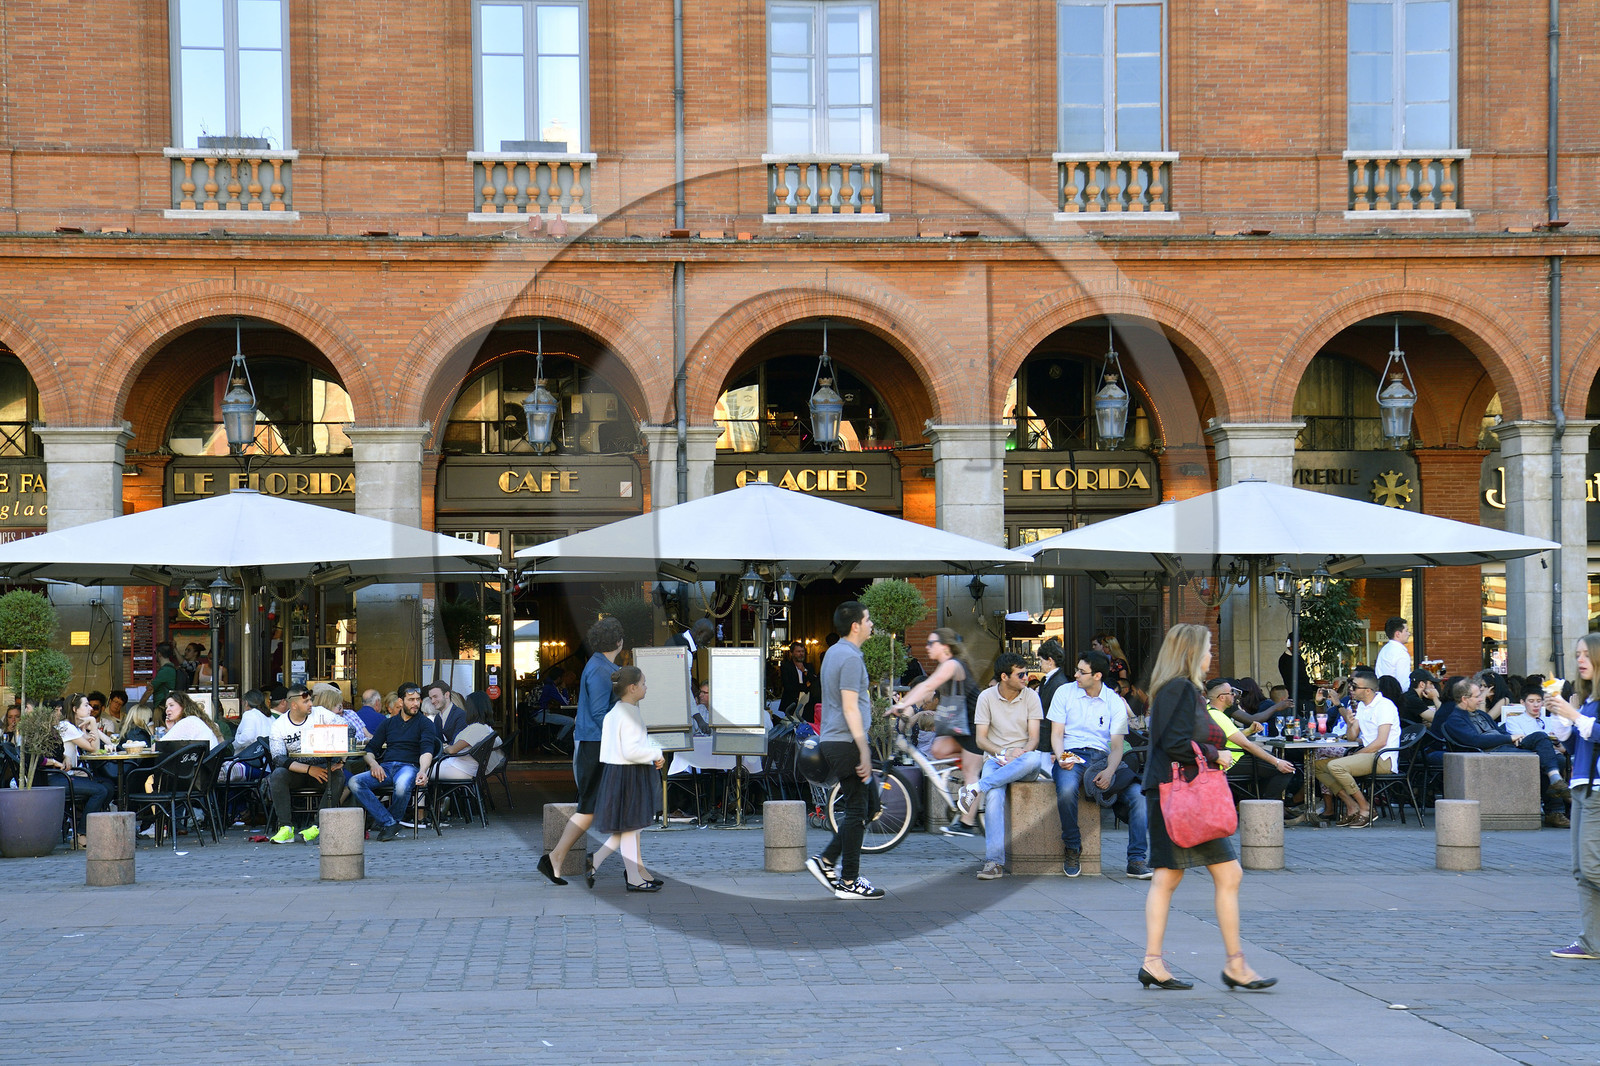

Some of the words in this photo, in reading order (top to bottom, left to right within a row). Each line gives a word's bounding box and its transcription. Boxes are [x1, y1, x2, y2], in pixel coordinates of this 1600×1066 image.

[174, 472, 214, 494] LE
[229, 472, 356, 495] FLORIDA
[498, 470, 579, 493] CAFE
[736, 469, 868, 492] GLACIER
[1022, 467, 1150, 490] FLORIDA
